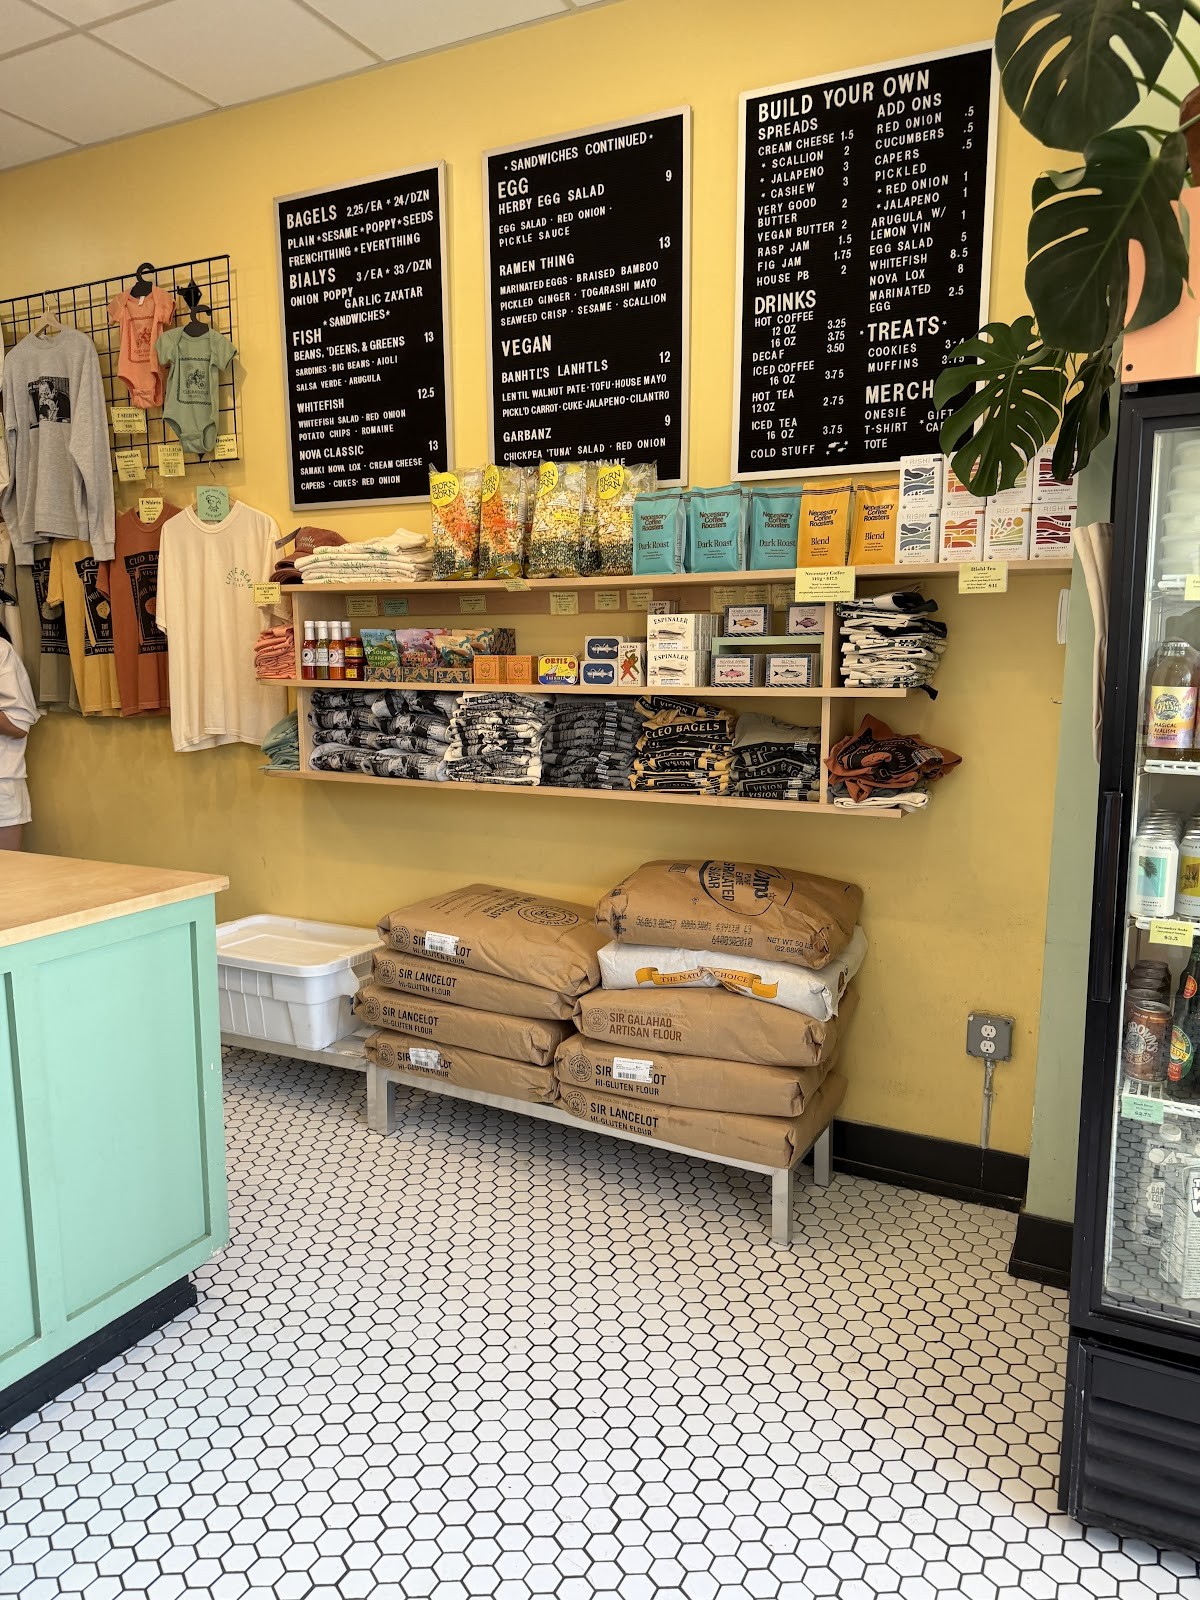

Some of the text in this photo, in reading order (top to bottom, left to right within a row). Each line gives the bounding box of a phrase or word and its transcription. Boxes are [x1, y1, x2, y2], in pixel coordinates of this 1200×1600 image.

[758, 69, 930, 123] BUILD YOUR OWN
[877, 92, 942, 119] ADD ONS
[757, 117, 819, 141] SPREADS
[876, 111, 942, 135] RED ONION
[757, 129, 854, 157] CREAM CHEESE 1.5
[875, 127, 945, 150] CUCUMBERS
[771, 145, 850, 169] SCALLION 2
[874, 148, 920, 166] CAPERS
[770, 161, 849, 184] JALAPENO 3
[875, 162, 927, 182] PICKLED
[497, 177, 529, 199] EGG
[498, 169, 673, 216] HERBY EGG SALAD 9
[770, 181, 816, 199] CASHEW
[286, 204, 337, 230] BAGELS
[499, 225, 570, 248] PICKLE SAUCE
[757, 219, 848, 243] VEGAN BUTTER 2
[870, 221, 931, 241] LEMON VIN
[869, 231, 967, 256] EGG SALAD 5
[499, 235, 671, 277] RAMEN THING 13
[869, 246, 968, 271] WHITEFISH 8.5
[289, 267, 336, 290] BIALYS
[756, 270, 810, 287] HOUSE PB
[869, 268, 925, 287] NOVA LOX
[290, 286, 354, 307] ONION POPPY
[344, 285, 423, 309] GARLIC ZA'ATAR
[500, 277, 657, 311] PICKLED GINGER TOGARASHI MAYO
[754, 289, 817, 316] DRINKS
[869, 283, 931, 302] MARINATED
[500, 292, 667, 327] SEAWEED CRISP SESAME SCALLION
[754, 310, 814, 328] HOT COFFEE
[292, 327, 322, 347] FISH
[867, 315, 940, 343] TREATS
[501, 334, 552, 357] VEGAN
[867, 342, 917, 358] COOKIES
[752, 360, 815, 377] ICED COFFEE
[867, 357, 919, 373] MUFFINS
[295, 373, 382, 392] SALSA VERDE ARUGULA
[865, 378, 934, 405] MERCH
[296, 386, 435, 414] WHITEFISH 12.5
[864, 406, 906, 421] ONESIE
[298, 423, 394, 442] POTATO CHIPS ROMAINE
[502, 414, 671, 443] GARBANZ 9
[864, 421, 908, 435] T-SHIRT
[299, 439, 439, 461] NOVA CLASSIC 13
[750, 444, 816, 459] COLD STUFF
[863, 438, 888, 450] TOTE
[698, 539, 733, 549] Dark Roast
[759, 539, 796, 547] Dark Roast
[811, 536, 830, 546] Blend
[864, 531, 885, 540] Blend
[653, 616, 689, 625] ESPINALER
[653, 653, 689, 662] ESPINALER
[659, 701, 688, 713] VISION
[645, 722, 720, 739] CLEO BAGELS
[745, 766, 776, 777] CLEO
[753, 782, 783, 791] VISION
[767, 936, 780, 944] NET
[782, 939, 794, 947] WT
[398, 968, 458, 988] SIR LANCELOT
[659, 975, 678, 983] THE
[714, 970, 749, 984] CHOICE
[398, 980, 451, 997] HI-GLUTEN FLOUR
[382, 1006, 439, 1027] SIR LANCELOT
[382, 1017, 433, 1035] HI-GLUTEN FLOUR
[609, 1012, 672, 1029] SIR GALAHAD
[609, 1024, 682, 1042] ARTISAN FLOUR
[590, 1102, 659, 1128] SIR LANCELOT
[590, 1115, 653, 1137] HI-GLUTEN FLOUR
